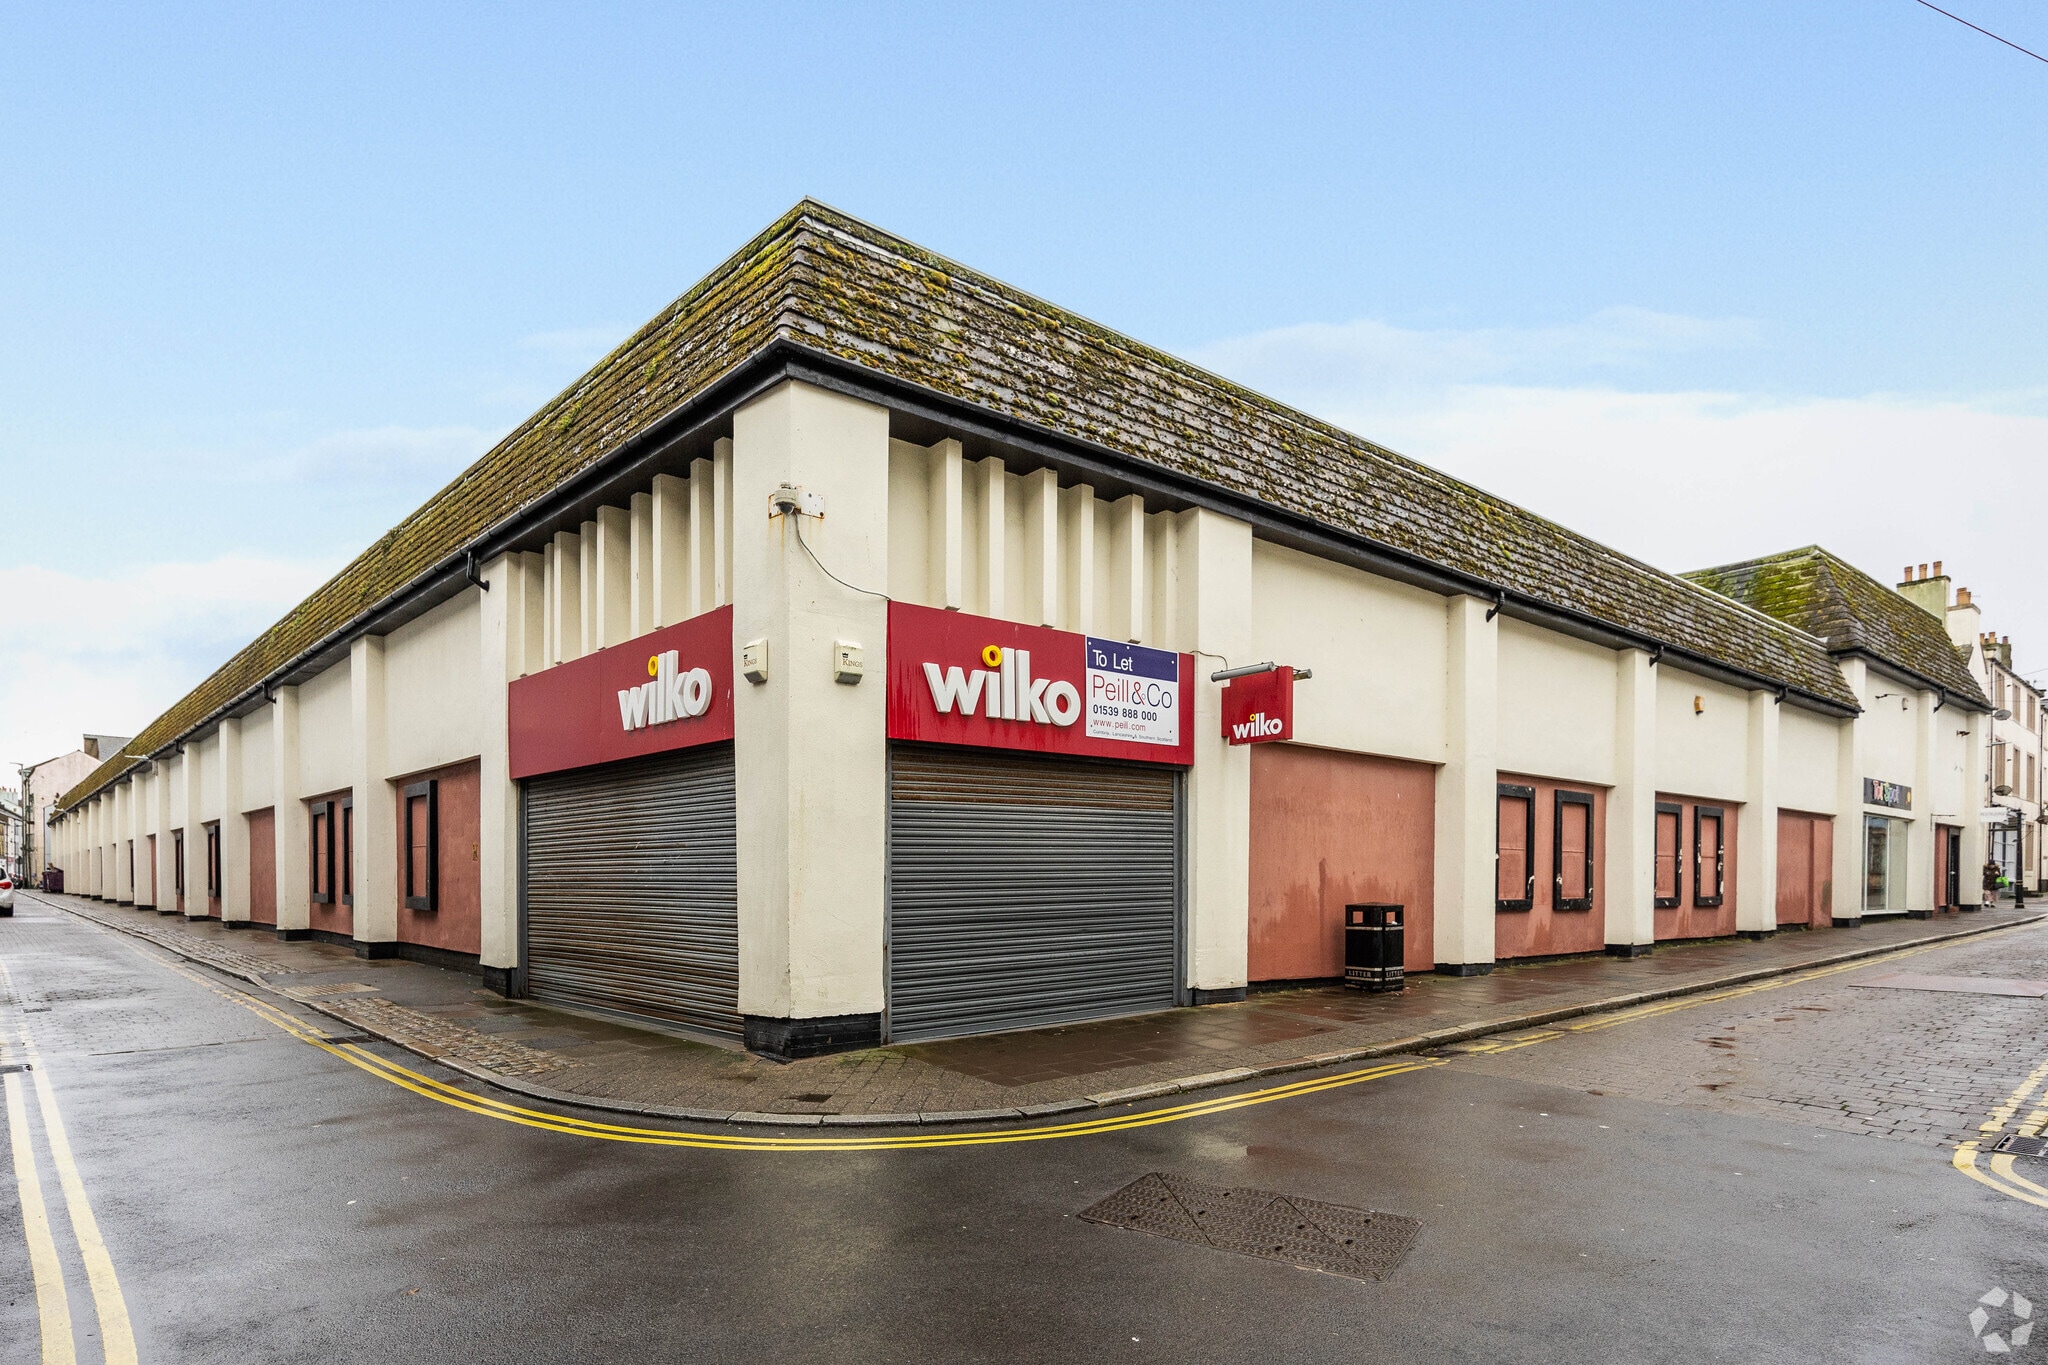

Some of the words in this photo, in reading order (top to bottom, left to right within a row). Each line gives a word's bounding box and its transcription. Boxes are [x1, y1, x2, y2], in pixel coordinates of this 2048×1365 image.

[1092, 649, 1107, 667] To
[1113, 653, 1133, 672] Let
[617, 650, 713, 731] wilko
[922, 645, 1081, 727] wilko
[1093, 704, 1119, 717] 01539
[1122, 708, 1138, 719] 888
[1141, 711, 1157, 721] 000
[1093, 720, 1146, 731] www.peill.com
[1232, 712, 1283, 739] wilko
[1348, 970, 1372, 978] LITTER
